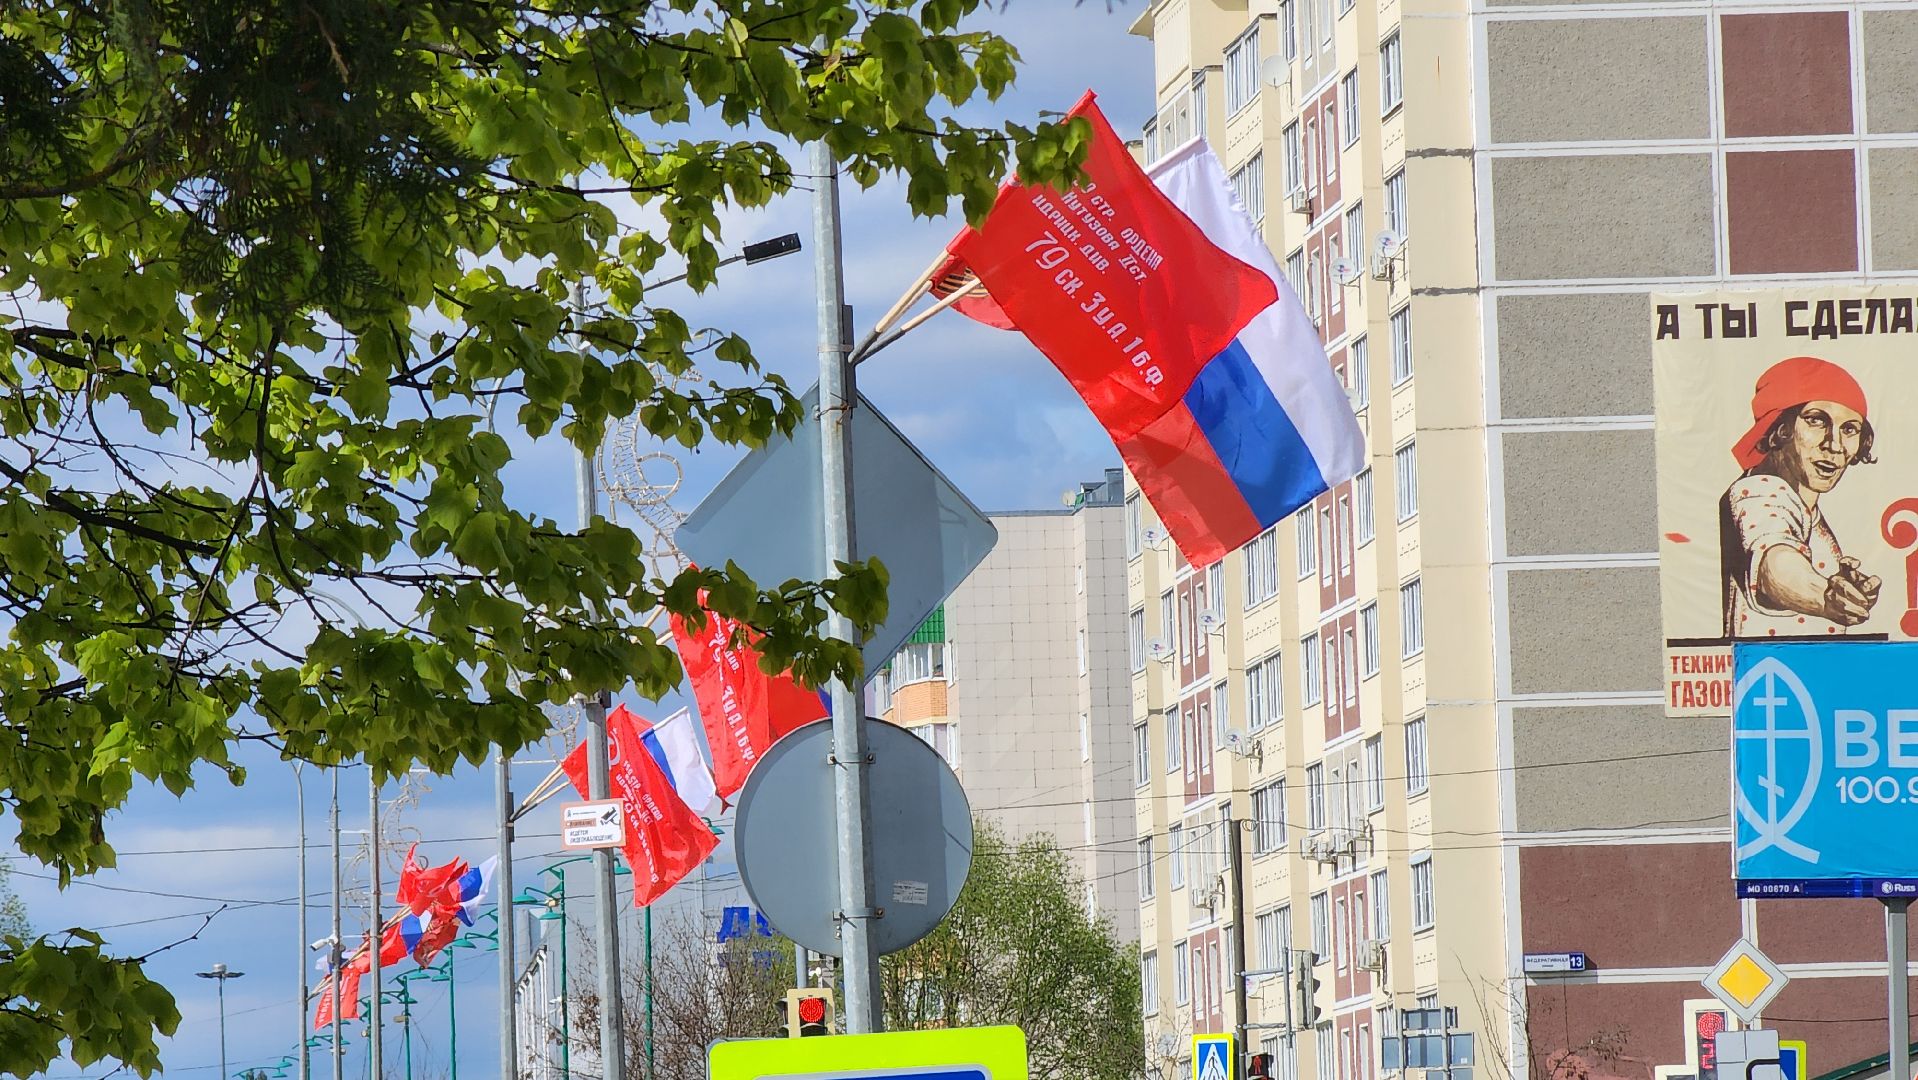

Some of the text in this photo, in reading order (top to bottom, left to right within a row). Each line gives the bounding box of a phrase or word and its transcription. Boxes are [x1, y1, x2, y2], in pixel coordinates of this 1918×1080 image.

[1025, 230, 1070, 270] 79
[1079, 244, 1110, 275] ДИВ.
[1656, 297, 1918, 340] А ТЫ СДЕЛА
[1894, 884, 1916, 892] Russ
[1570, 956, 1582, 967] 13
